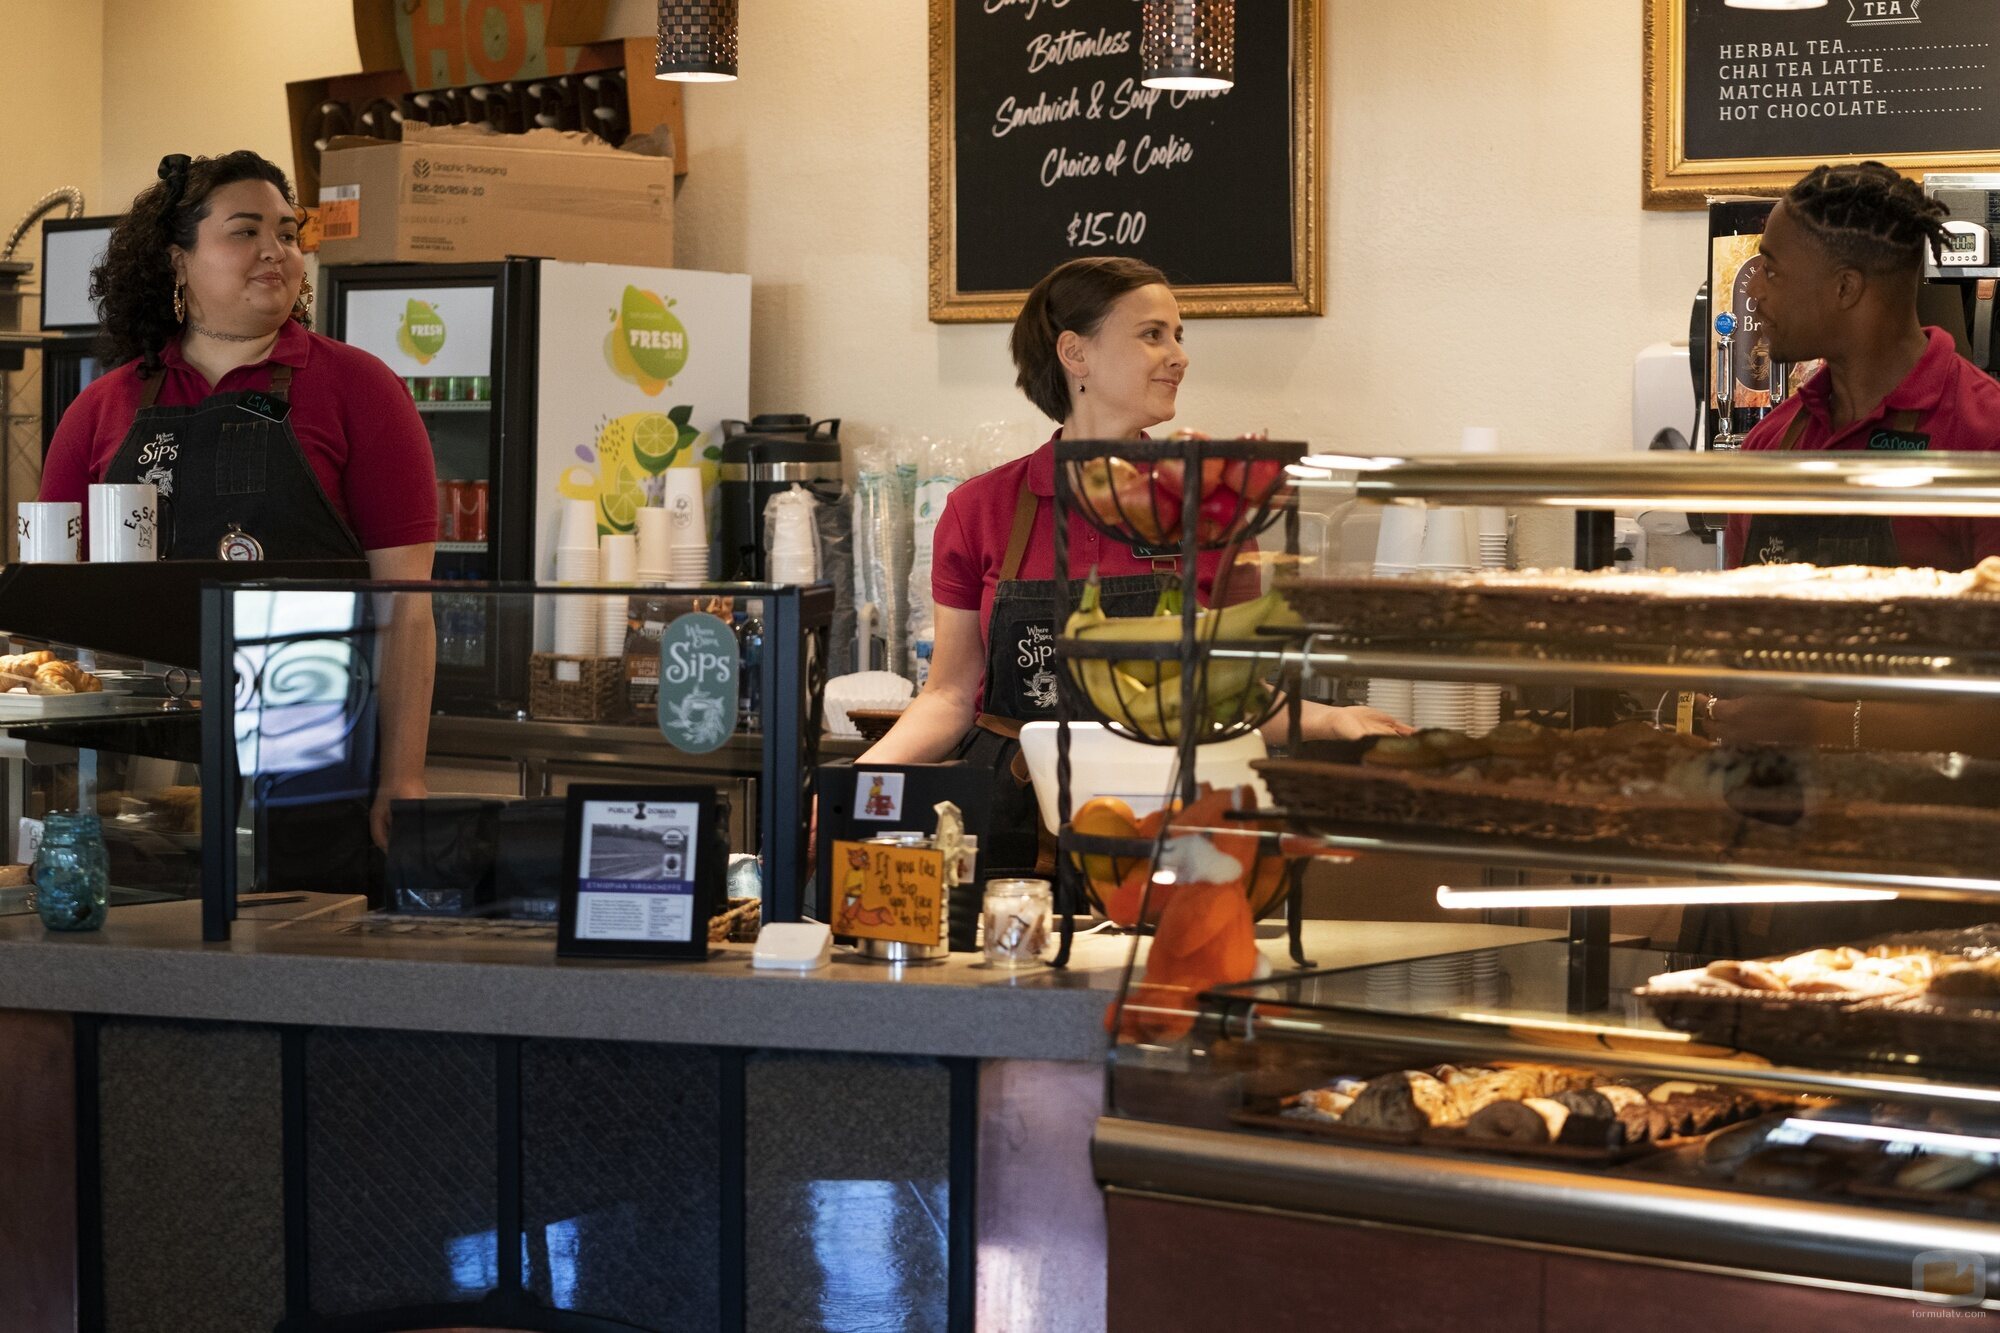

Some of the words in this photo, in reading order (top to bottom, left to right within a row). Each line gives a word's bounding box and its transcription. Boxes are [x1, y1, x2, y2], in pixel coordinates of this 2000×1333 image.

[1863, 0, 1902, 16] TEA
[1026, 27, 1132, 73] Bottomless
[1719, 41, 1798, 59] HERBAL
[1806, 39, 1844, 55] TEA
[1719, 62, 1768, 80] CHAI
[1775, 61, 1813, 77] TEA
[1822, 58, 1884, 75] LATTE
[1719, 83, 1803, 100] MATCHA
[1811, 79, 1874, 96] LATTE
[992, 86, 1081, 137] Sandwich
[1086, 80, 1104, 119] &
[1109, 77, 1162, 120] Soup
[1719, 105, 1760, 121] HOT
[1767, 100, 1888, 119] CHOCOLATE
[1041, 147, 1102, 187] Choice
[1105, 139, 1127, 176] of
[1133, 134, 1193, 175] Cookie
[1066, 211, 1147, 247] $15.00
[1739, 266, 1757, 294] FAIR
[411, 325, 443, 336] FRESH
[1744, 315, 1761, 332] Br
[629, 329, 683, 351] FRESH
[138, 442, 179, 464] Sips
[1026, 625, 1049, 636] Where
[1033, 633, 1053, 643] Essex
[666, 642, 730, 683] Sips
[1017, 638, 1056, 668] Sip
